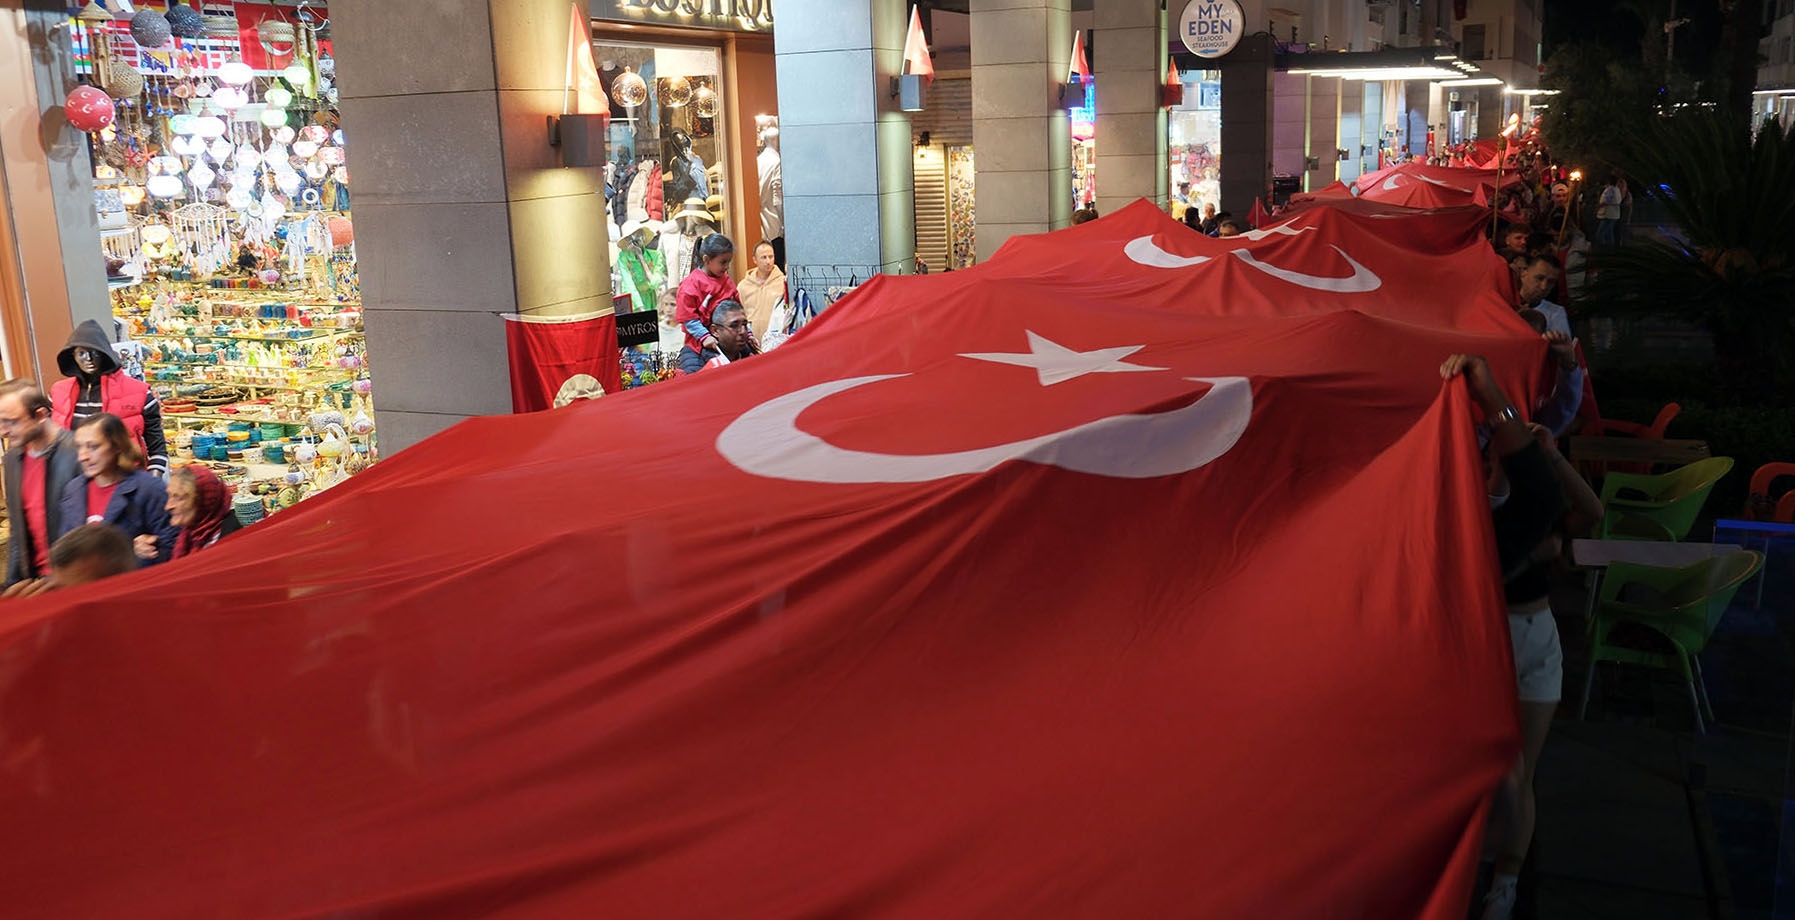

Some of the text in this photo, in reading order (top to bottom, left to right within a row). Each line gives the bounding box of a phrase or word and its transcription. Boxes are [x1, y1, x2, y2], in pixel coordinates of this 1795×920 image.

[1198, 4, 1223, 19] MY
[1188, 19, 1232, 36] EDEN
[1192, 41, 1229, 49] STEAKHOUSE
